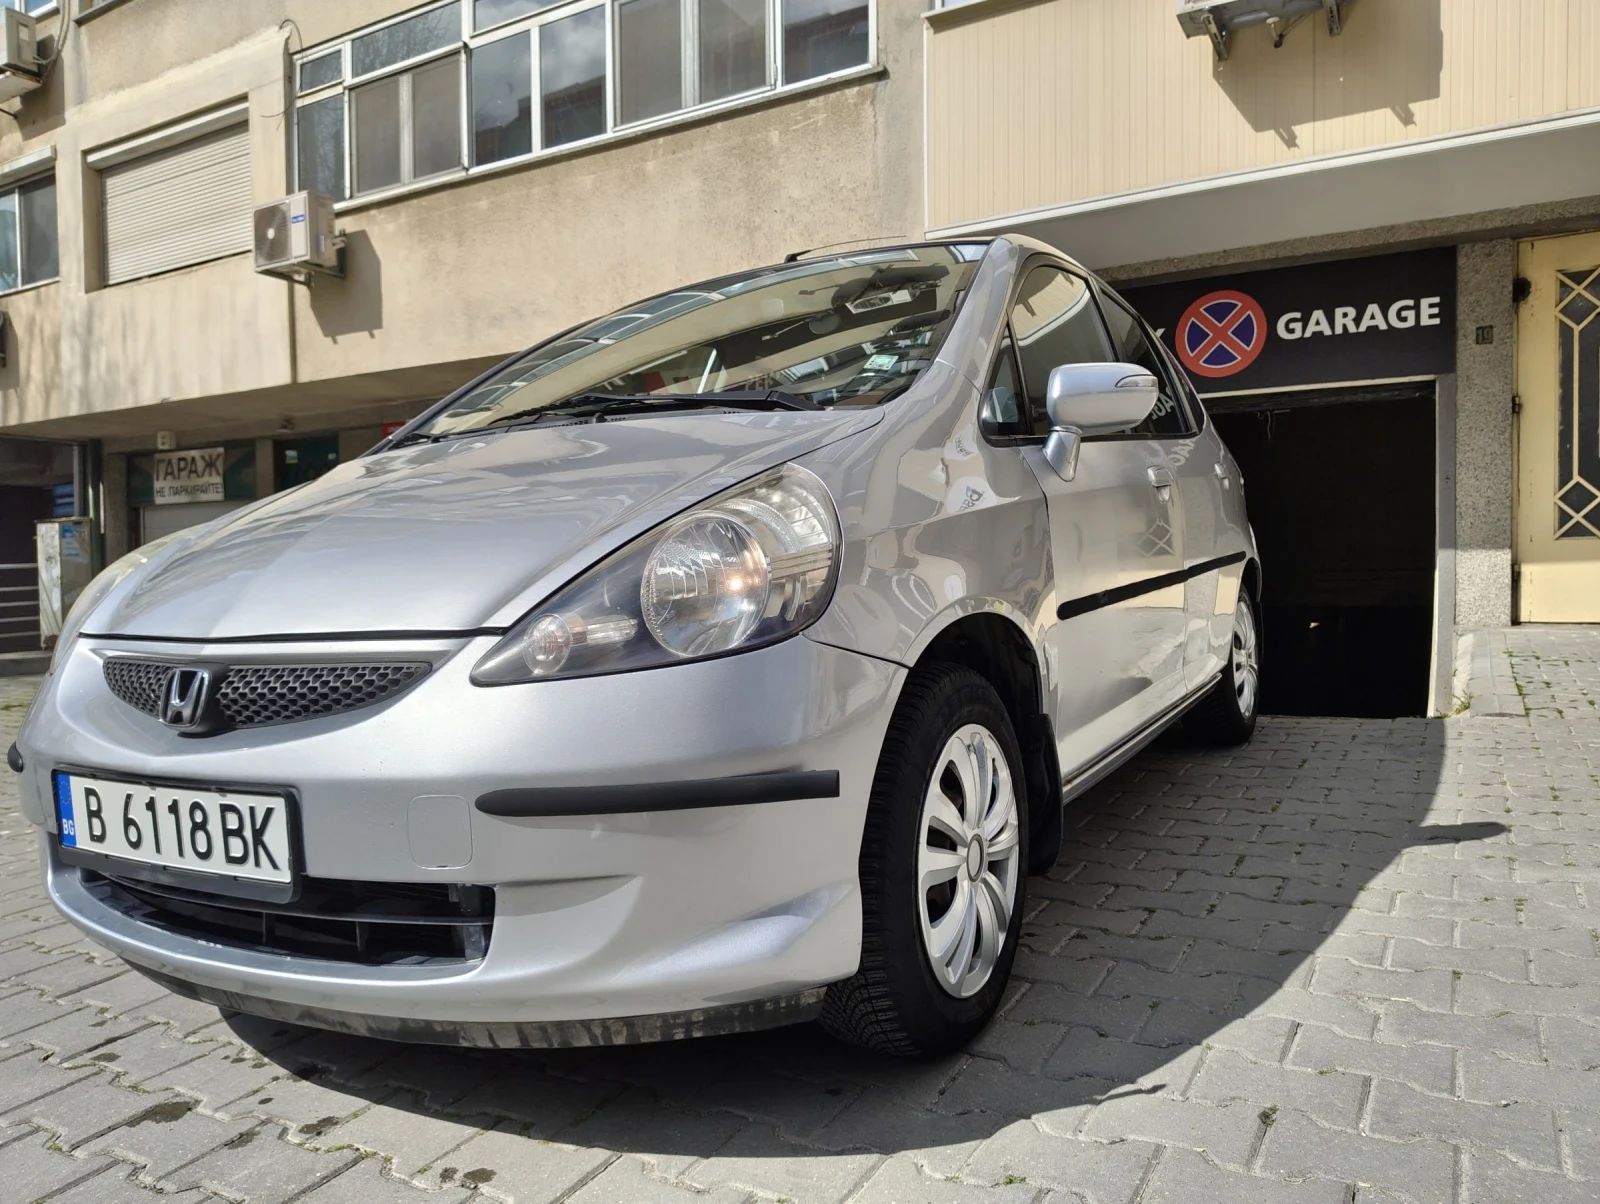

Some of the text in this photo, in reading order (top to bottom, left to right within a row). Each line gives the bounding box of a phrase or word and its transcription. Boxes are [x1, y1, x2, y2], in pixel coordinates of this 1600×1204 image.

[1276, 296, 1441, 341] GARAGE
[156, 453, 223, 481] ГАРАЖ
[156, 486, 166, 498] НЕ
[62, 818, 75, 837] BG
[84, 785, 107, 845] B
